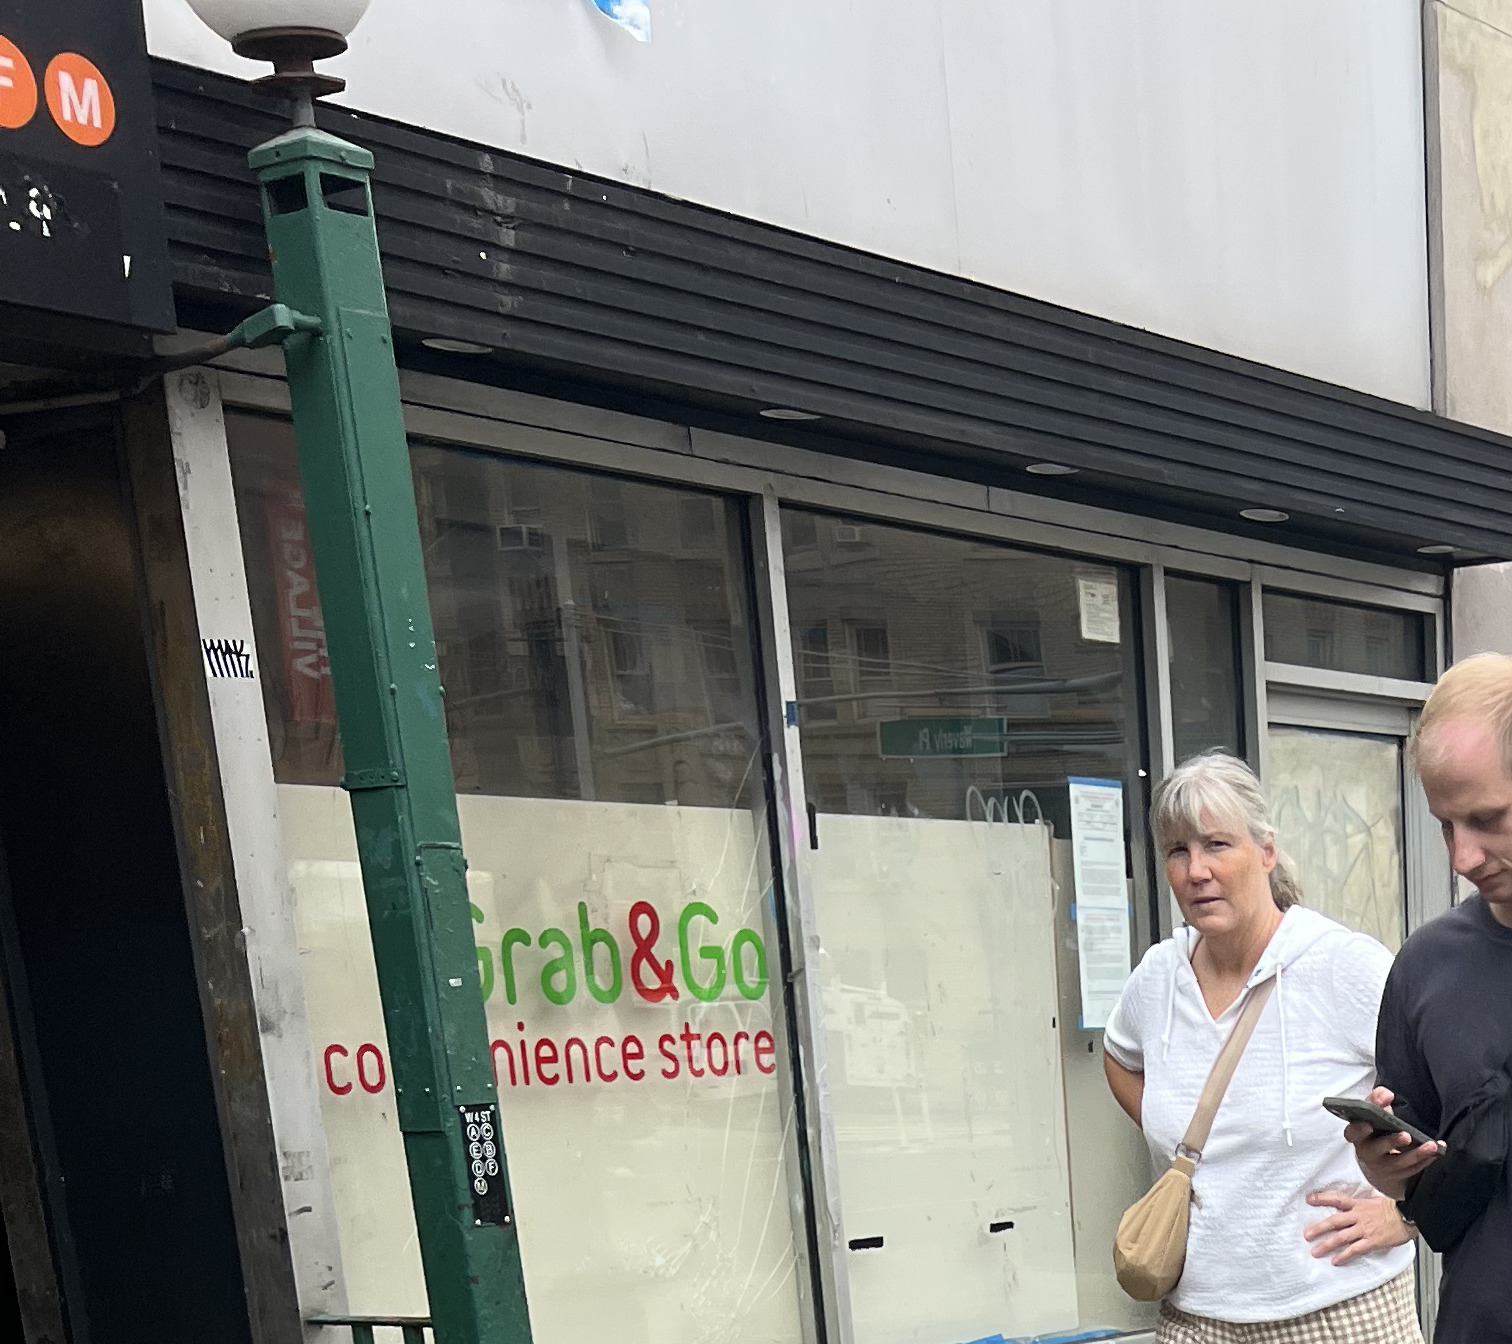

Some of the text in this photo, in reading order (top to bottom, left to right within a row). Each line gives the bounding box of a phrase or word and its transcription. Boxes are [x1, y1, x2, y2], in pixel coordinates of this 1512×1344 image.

[57, 70, 102, 128] M
[323, 1022, 776, 1096] conience store
[464, 1111, 474, 1123] W
[480, 1110, 491, 1123] ST
